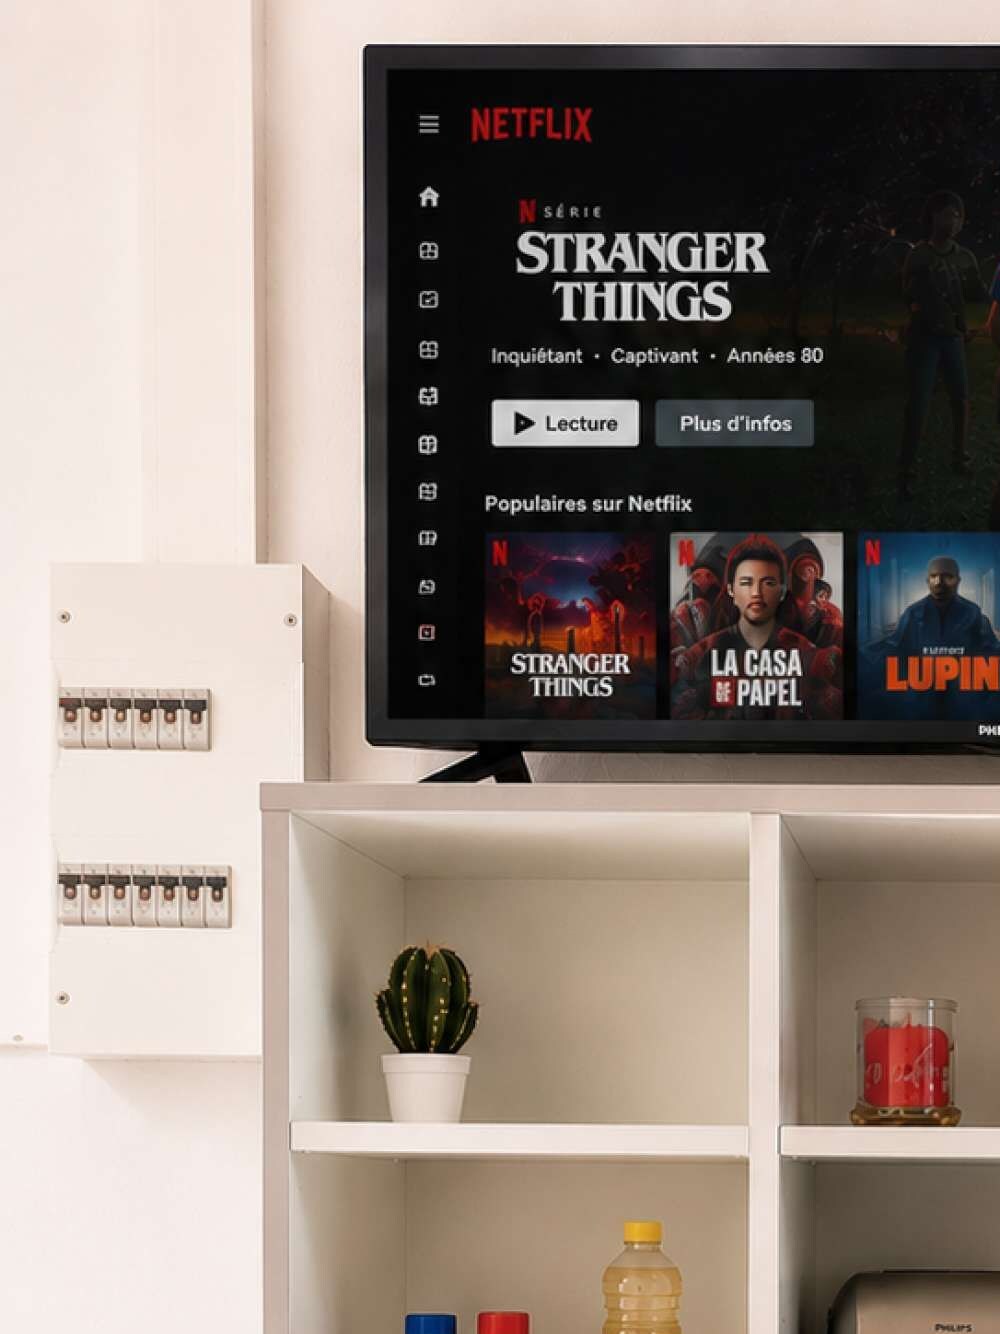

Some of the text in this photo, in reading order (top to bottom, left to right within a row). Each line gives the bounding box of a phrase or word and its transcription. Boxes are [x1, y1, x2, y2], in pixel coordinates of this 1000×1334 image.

[471, 107, 592, 142] NETFLIX
[516, 231, 770, 274] STRANGER
[552, 281, 732, 321] THINGS
[491, 348, 824, 367] Inquiétant Captivant Années 80
[546, 415, 618, 432] Lecture
[680, 415, 721, 432] Plus
[485, 495, 692, 516] Populaires sur Netflix
[511, 653, 631, 675] STRANGER
[711, 648, 802, 677] LA CASA
[886, 656, 1000, 692] LUPIN
[528, 676, 614, 697] THINGS
[737, 678, 802, 706] PAPEL
